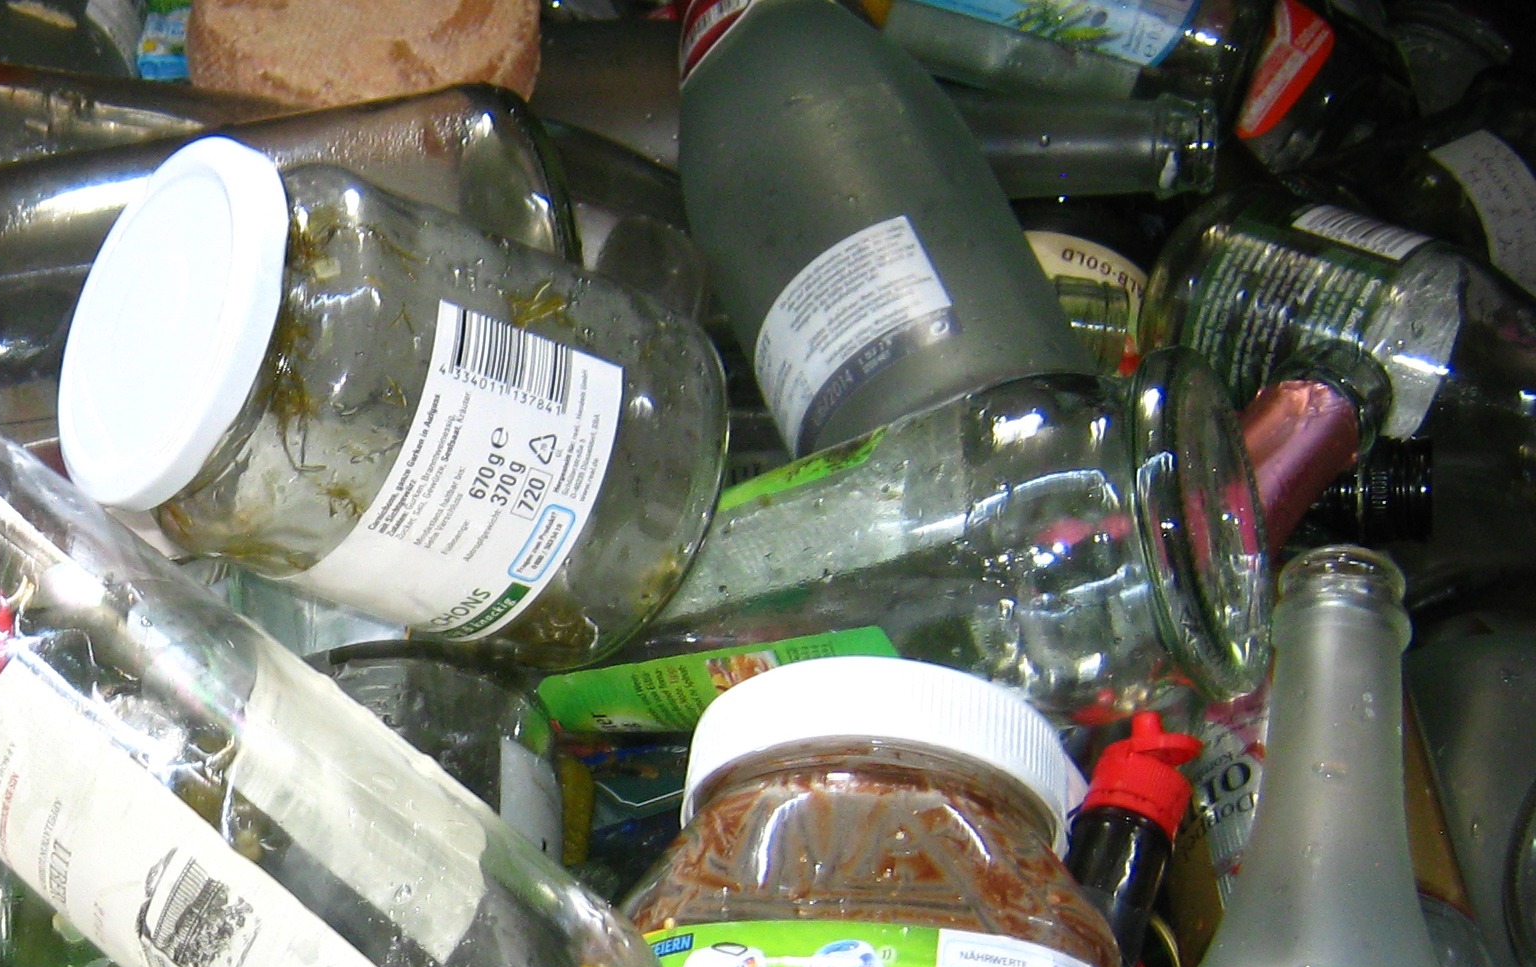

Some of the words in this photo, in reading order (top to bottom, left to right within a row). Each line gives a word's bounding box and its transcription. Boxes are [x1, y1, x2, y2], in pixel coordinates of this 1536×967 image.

[453, 369, 505, 395] 334011
[512, 390, 563, 416] 137841
[405, 438, 426, 468] Gurken
[467, 465, 496, 501] 670
[486, 451, 505, 468] g
[488, 472, 518, 508] 370
[508, 459, 527, 475] g
[514, 474, 548, 515] 720
